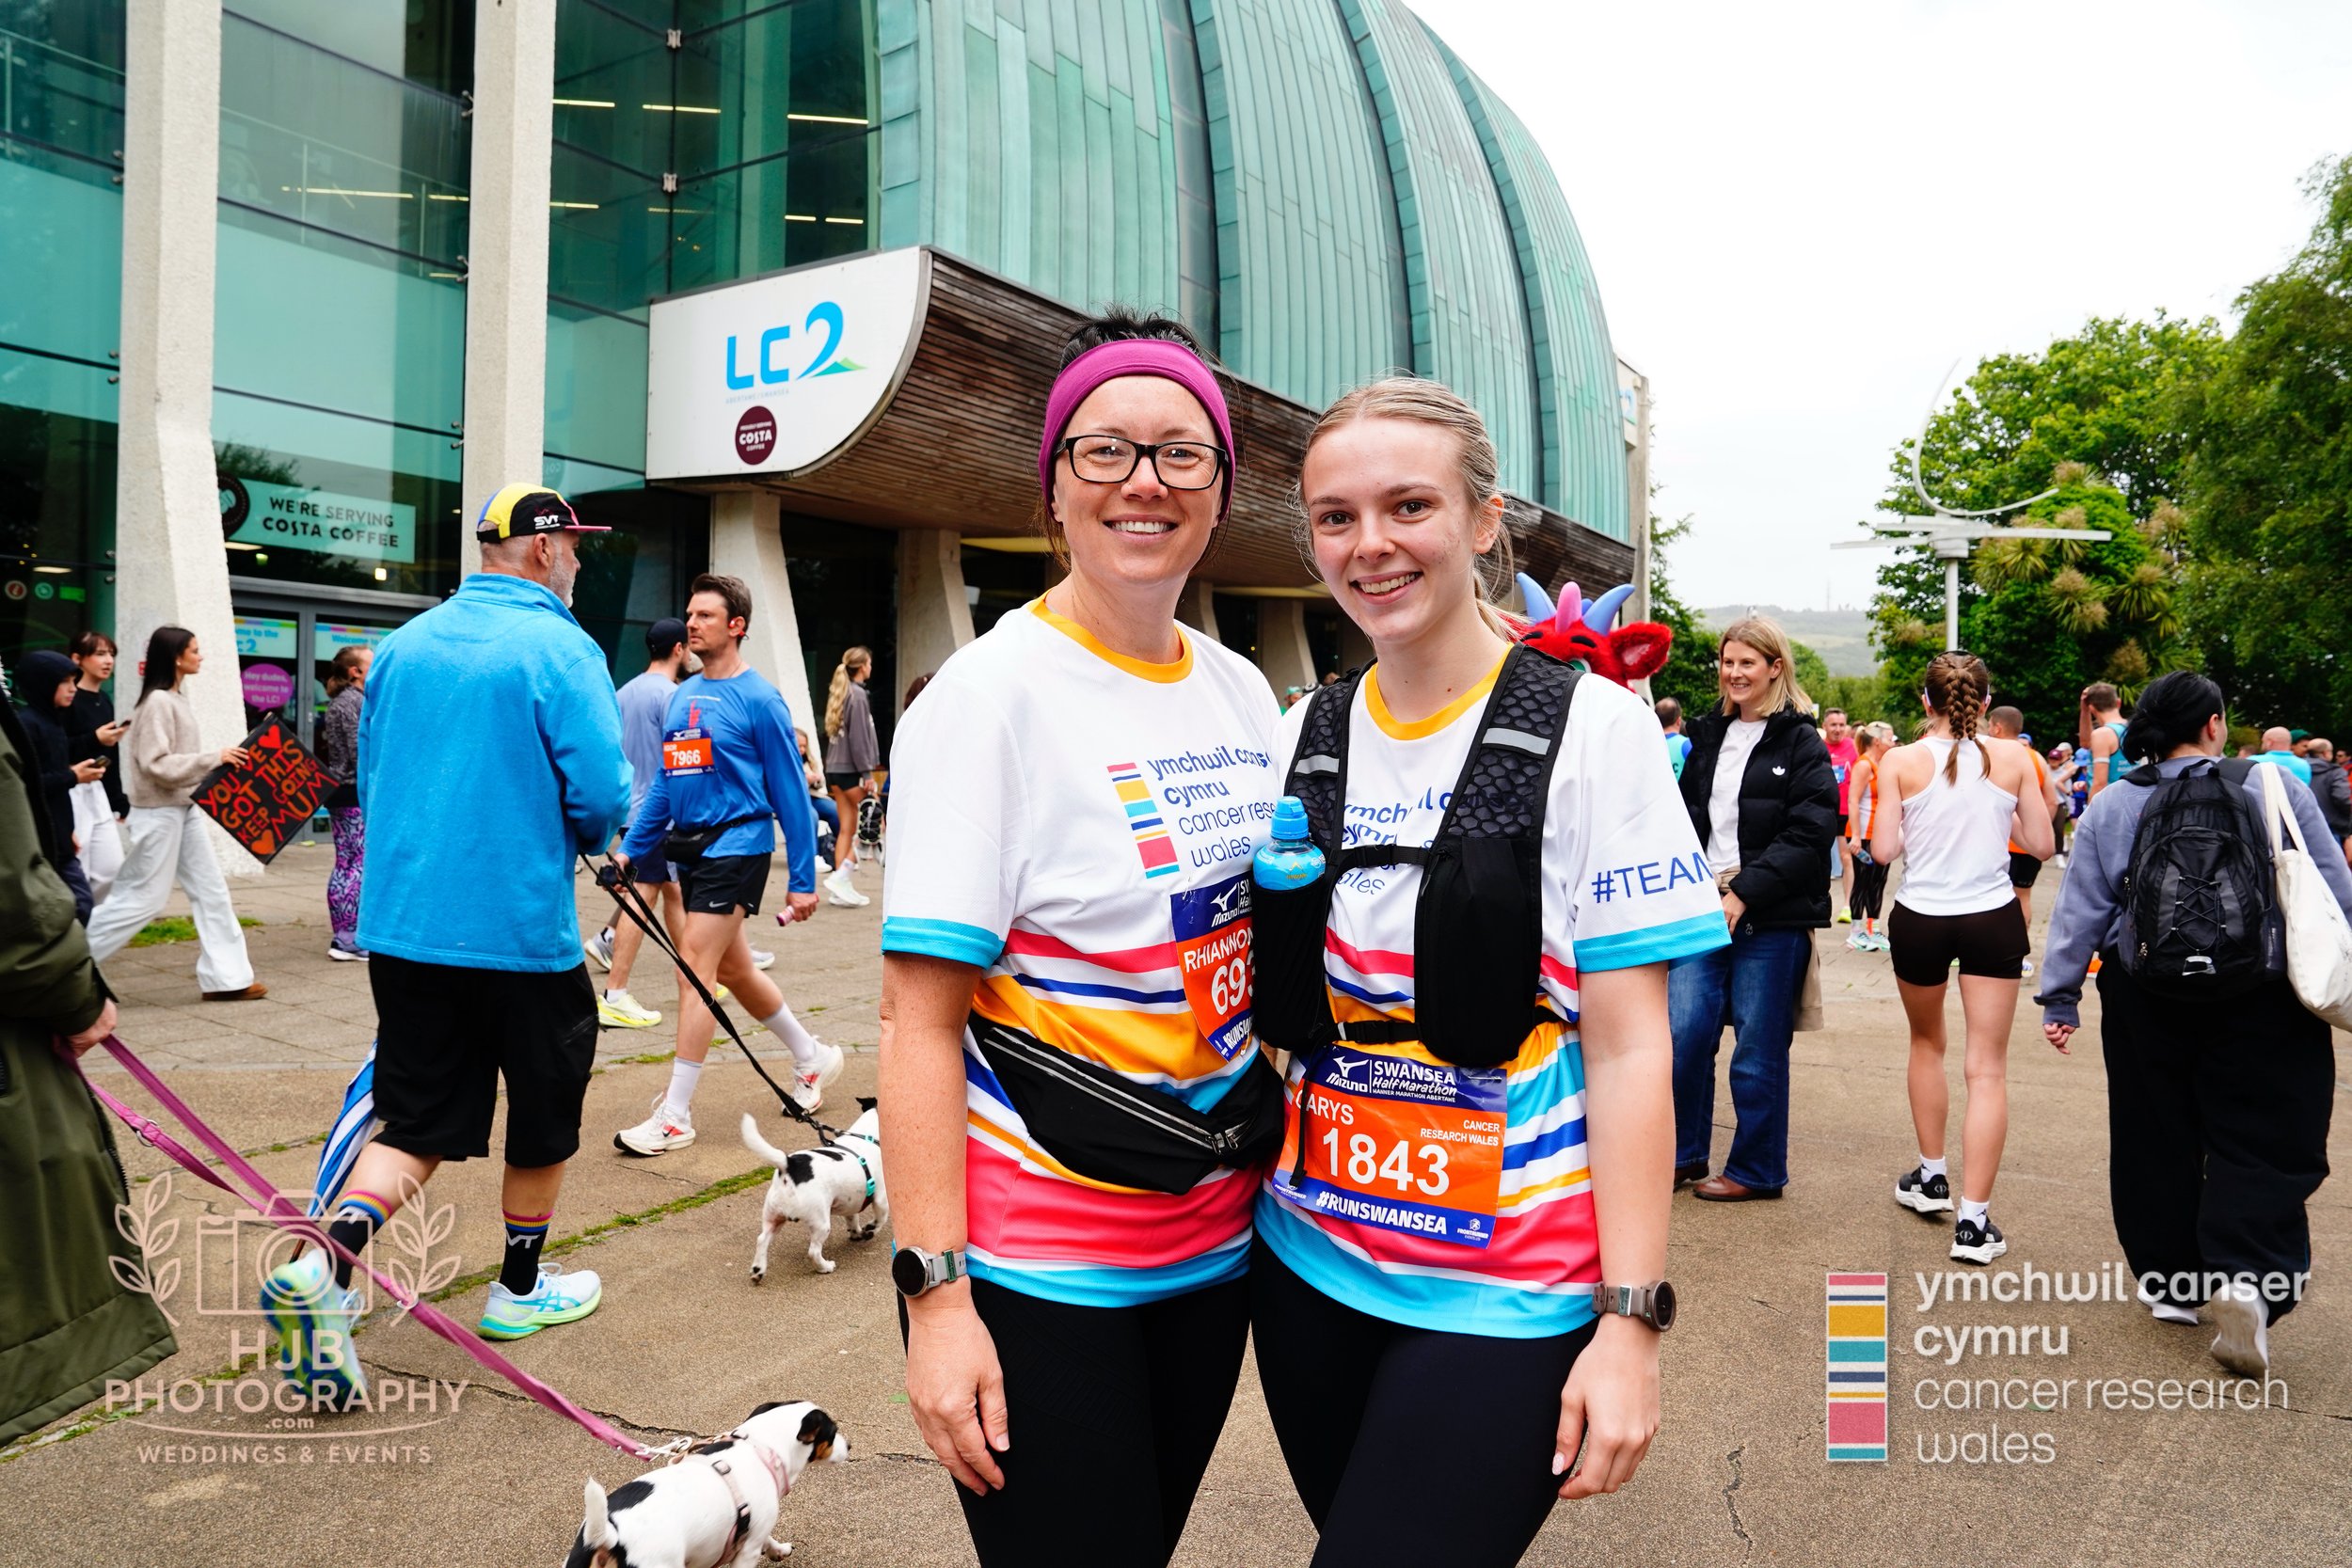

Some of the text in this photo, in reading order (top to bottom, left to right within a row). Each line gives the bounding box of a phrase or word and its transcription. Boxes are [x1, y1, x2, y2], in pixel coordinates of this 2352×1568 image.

[739, 429, 772, 445] COSTA
[269, 497, 394, 528] WE'RE SERVING
[262, 516, 399, 547] COSTA COFFEE
[672, 750, 702, 767] 7966
[1147, 745, 1236, 782] ymchwil
[220, 739, 304, 829] GOT THIS
[1163, 780, 1231, 808] cymru
[237, 758, 320, 845] KEEP GOING
[270, 771, 341, 842] MUM
[1178, 805, 1245, 835] cancer
[1190, 835, 1251, 868] wales
[1374, 1060, 1456, 1085] SWANSEA
[1395, 1091, 1425, 1100] MARATHON
[1420, 1128, 1499, 1147] RESEARCH WALES
[1463, 1119, 1501, 1133] CANCER
[1323, 1128, 1451, 1196] 1843
[1316, 1190, 1447, 1235] #RUNSWANSEA
